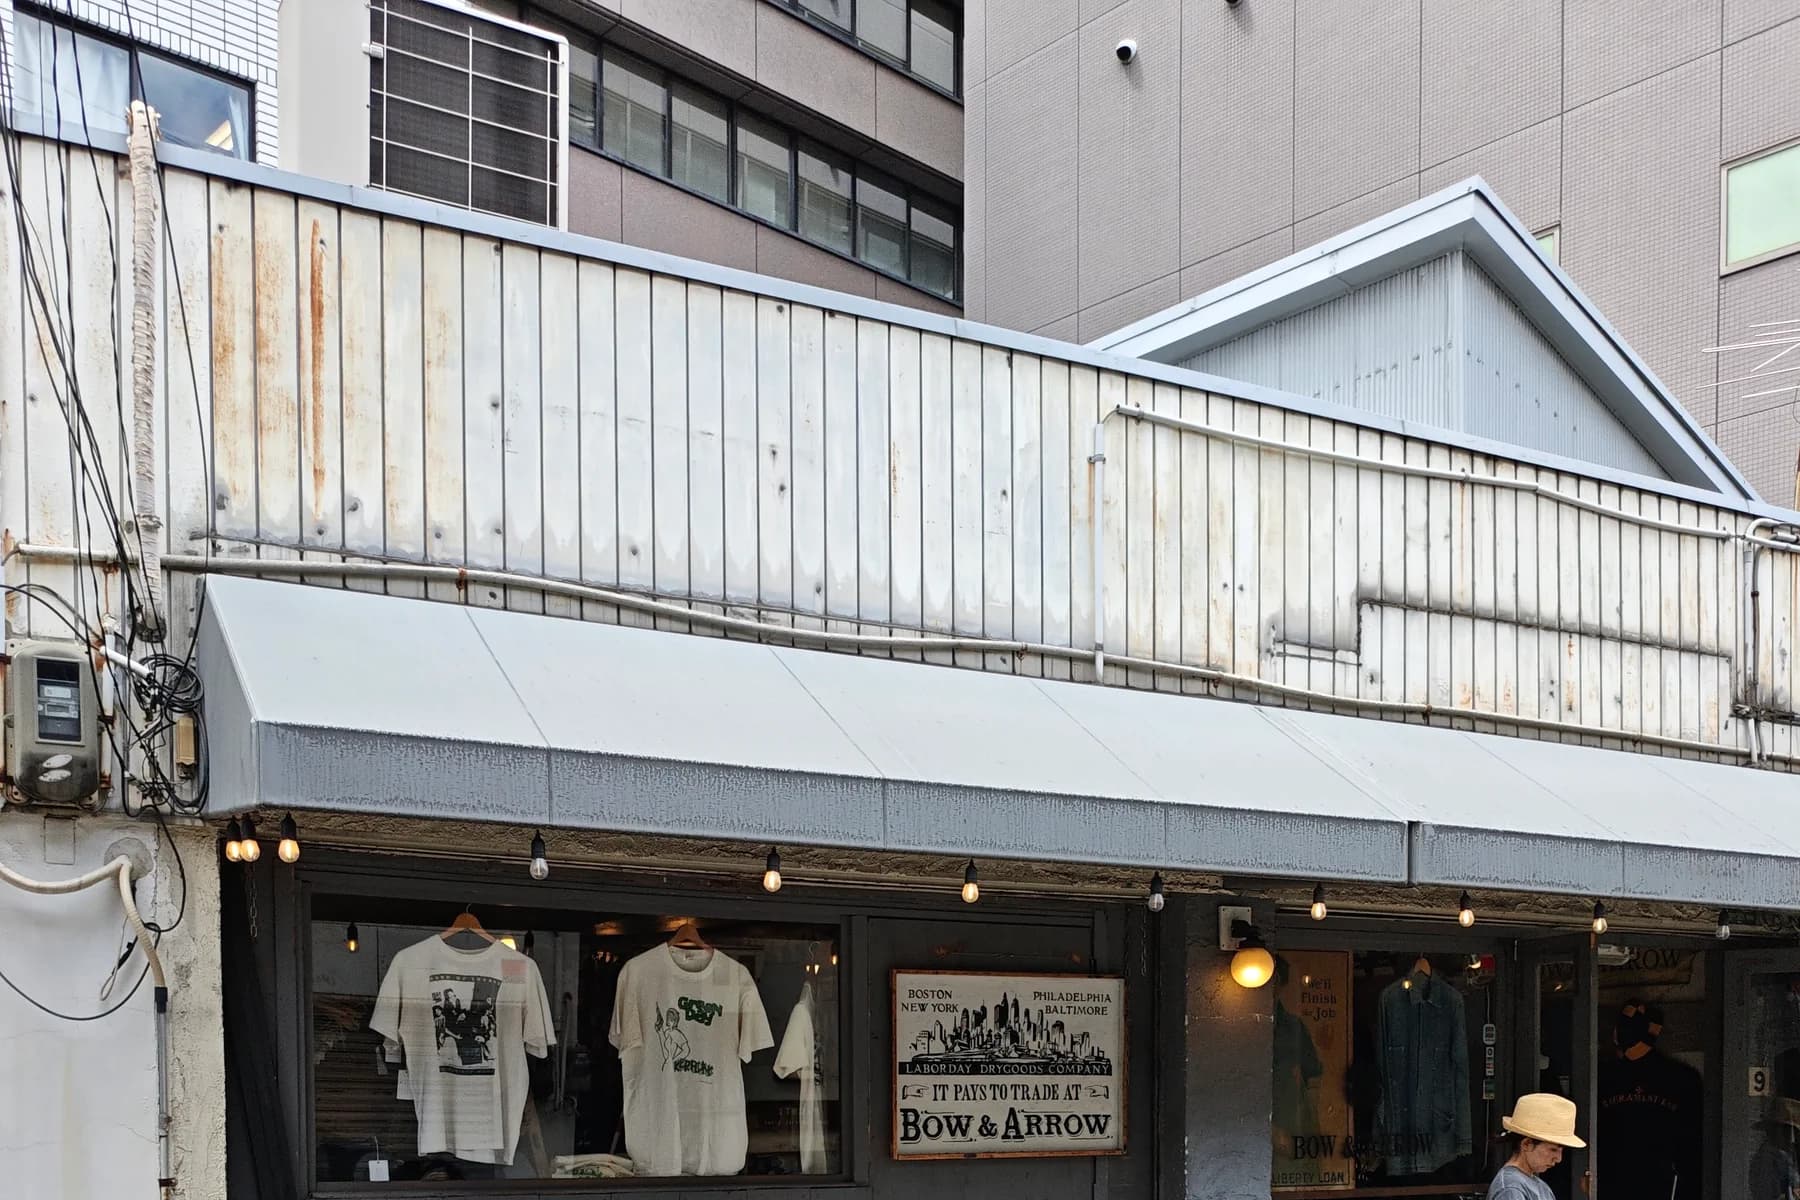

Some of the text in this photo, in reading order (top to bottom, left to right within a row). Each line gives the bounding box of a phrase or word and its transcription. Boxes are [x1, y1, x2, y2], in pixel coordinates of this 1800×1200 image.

[907, 988, 953, 1000] BOSTON
[1033, 991, 1112, 1003] PHILADELPHIA
[901, 1002, 959, 1014] NEW YORK
[1044, 1005, 1108, 1016] BALTIMORE
[1048, 1064, 1110, 1075] COMPANY
[1754, 1070, 1766, 1093] 9
[932, 1083, 1082, 1102] IT PAYS TO TRADE AT
[900, 1106, 1112, 1142] BOW & ARROW
[1293, 1135, 1336, 1160] BOW
[1319, 1171, 1344, 1184] LOAN
